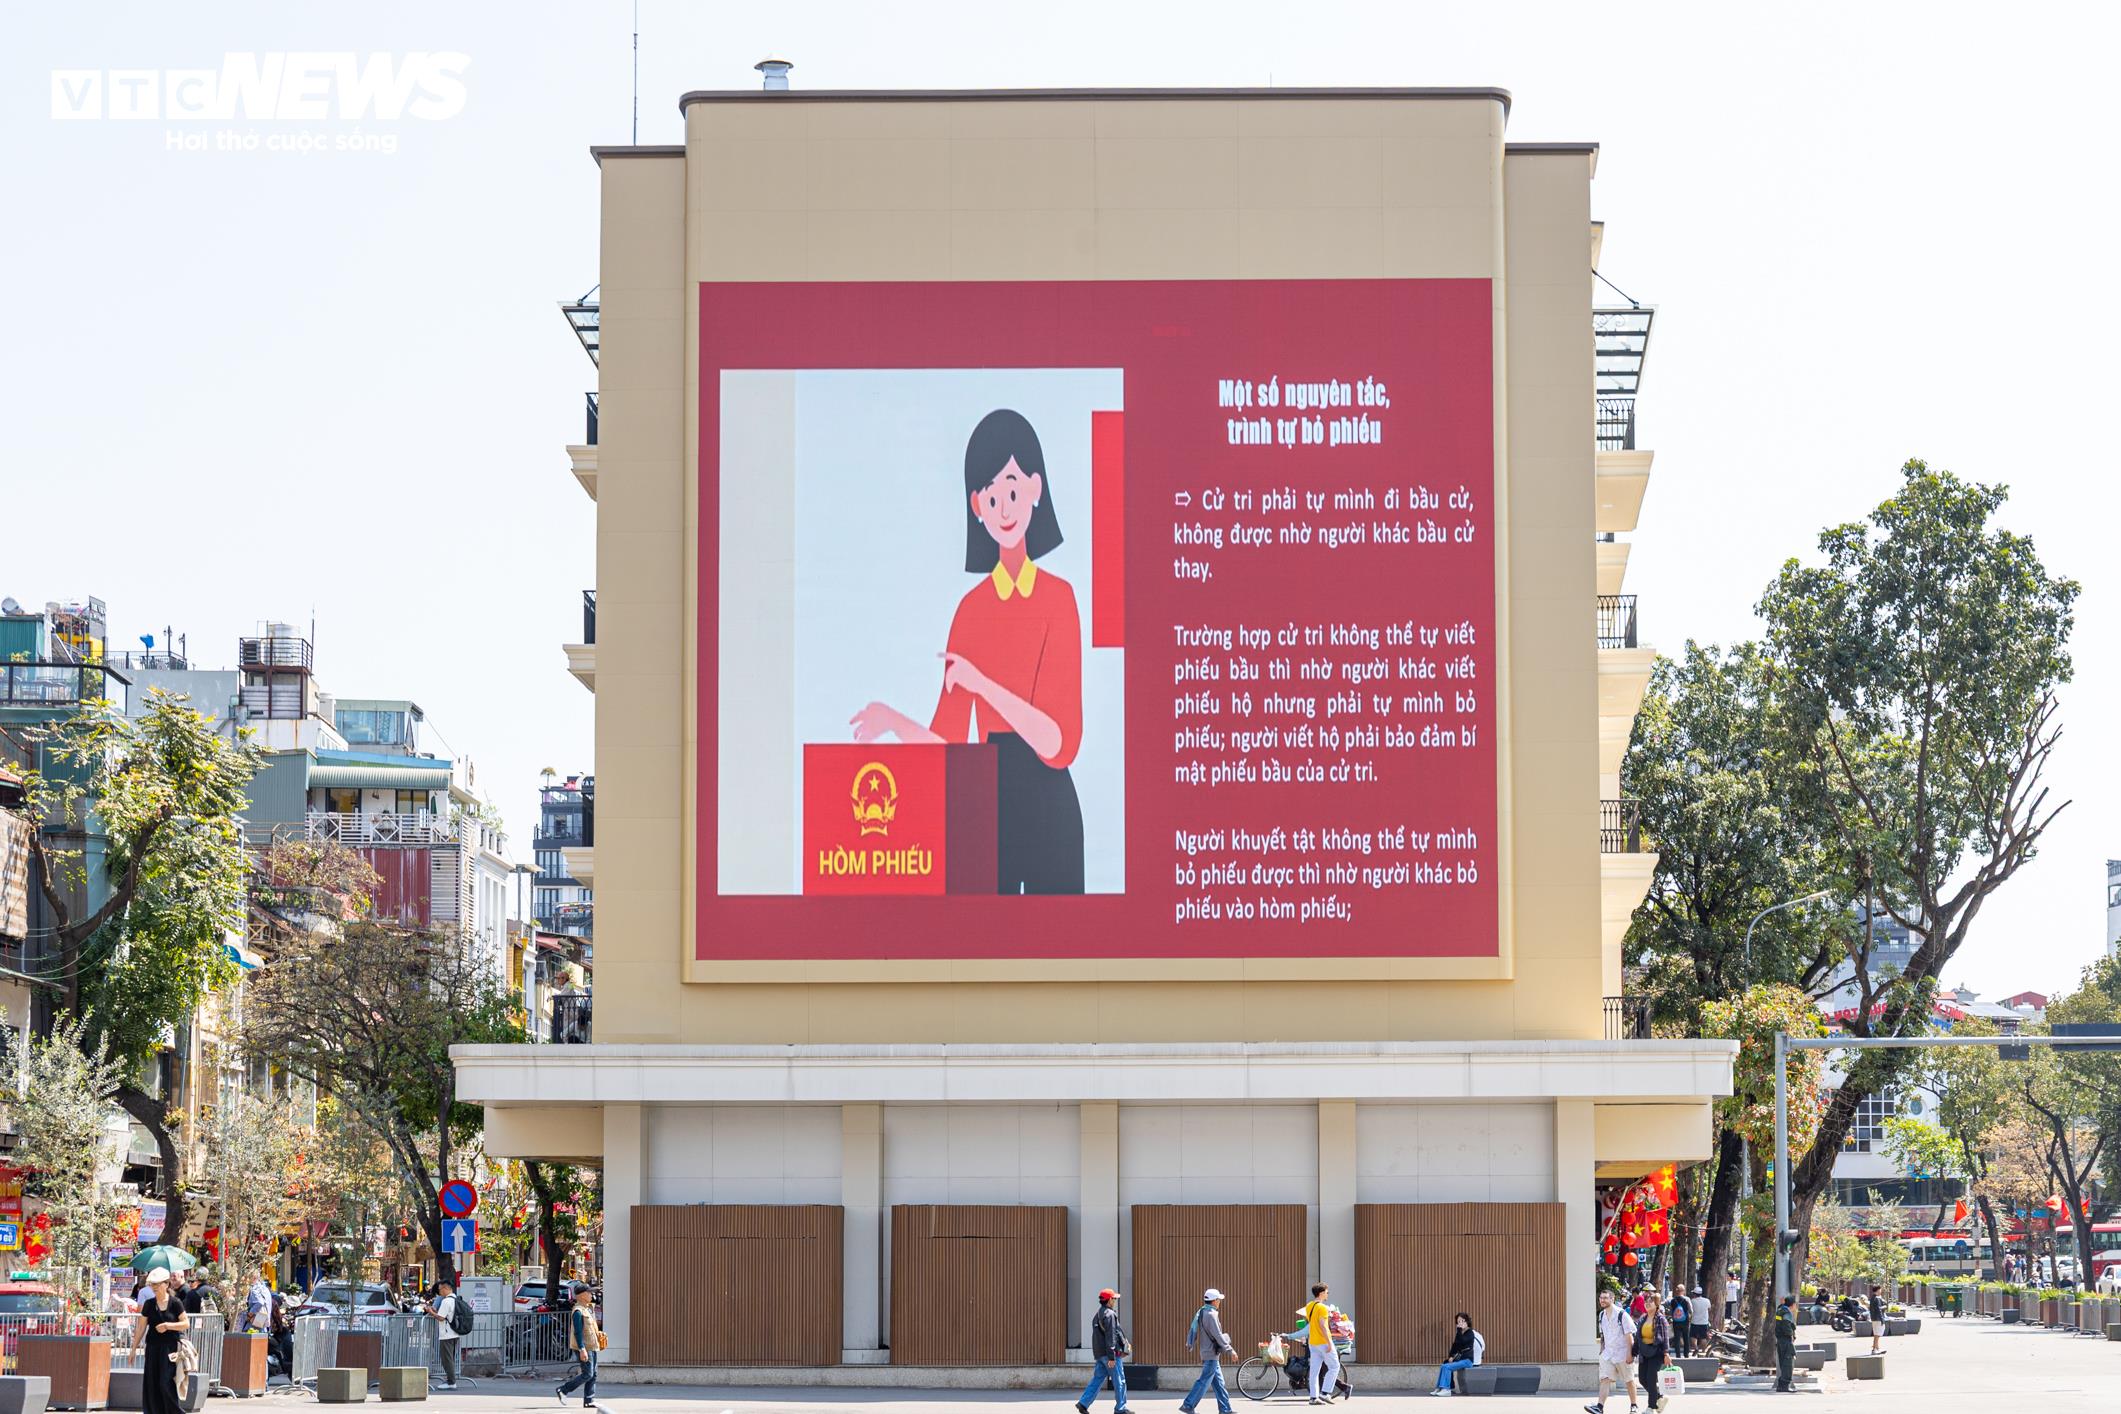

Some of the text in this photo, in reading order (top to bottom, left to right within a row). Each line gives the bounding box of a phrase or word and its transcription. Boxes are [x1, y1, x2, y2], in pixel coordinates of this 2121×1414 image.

[1218, 374, 1391, 412] Một số nguyên tắc,
[1226, 411, 1382, 450] trình tự bỏ phiếu
[1202, 484, 1474, 515] Cử tri phải tự mình đi bầu cử,
[1174, 518, 1475, 550] không được nhờ người khác bầu cử
[1173, 556, 1213, 583] thay.
[1173, 619, 1476, 651] Trường hợp cử tri không thể tự viết
[1174, 654, 1476, 685] phiếu bầu thì nhờ người khác viết
[1174, 688, 1476, 720] phiếu hộ nhưng phải tự mình bỏ
[1174, 722, 1477, 753] phiếu; người viết hộ phải bảo đảm bí
[1175, 757, 1378, 788] mật phiếu bầu của cử tri.
[1175, 824, 1477, 856] Người khuyết tật không thể tự mình
[819, 843, 932, 876] HÒM PHIẾU
[1175, 859, 1478, 890] bỏ phiếu được thì nhờ người khác bỏ
[1175, 893, 1352, 924] phiếu vào hòm phiếu;
